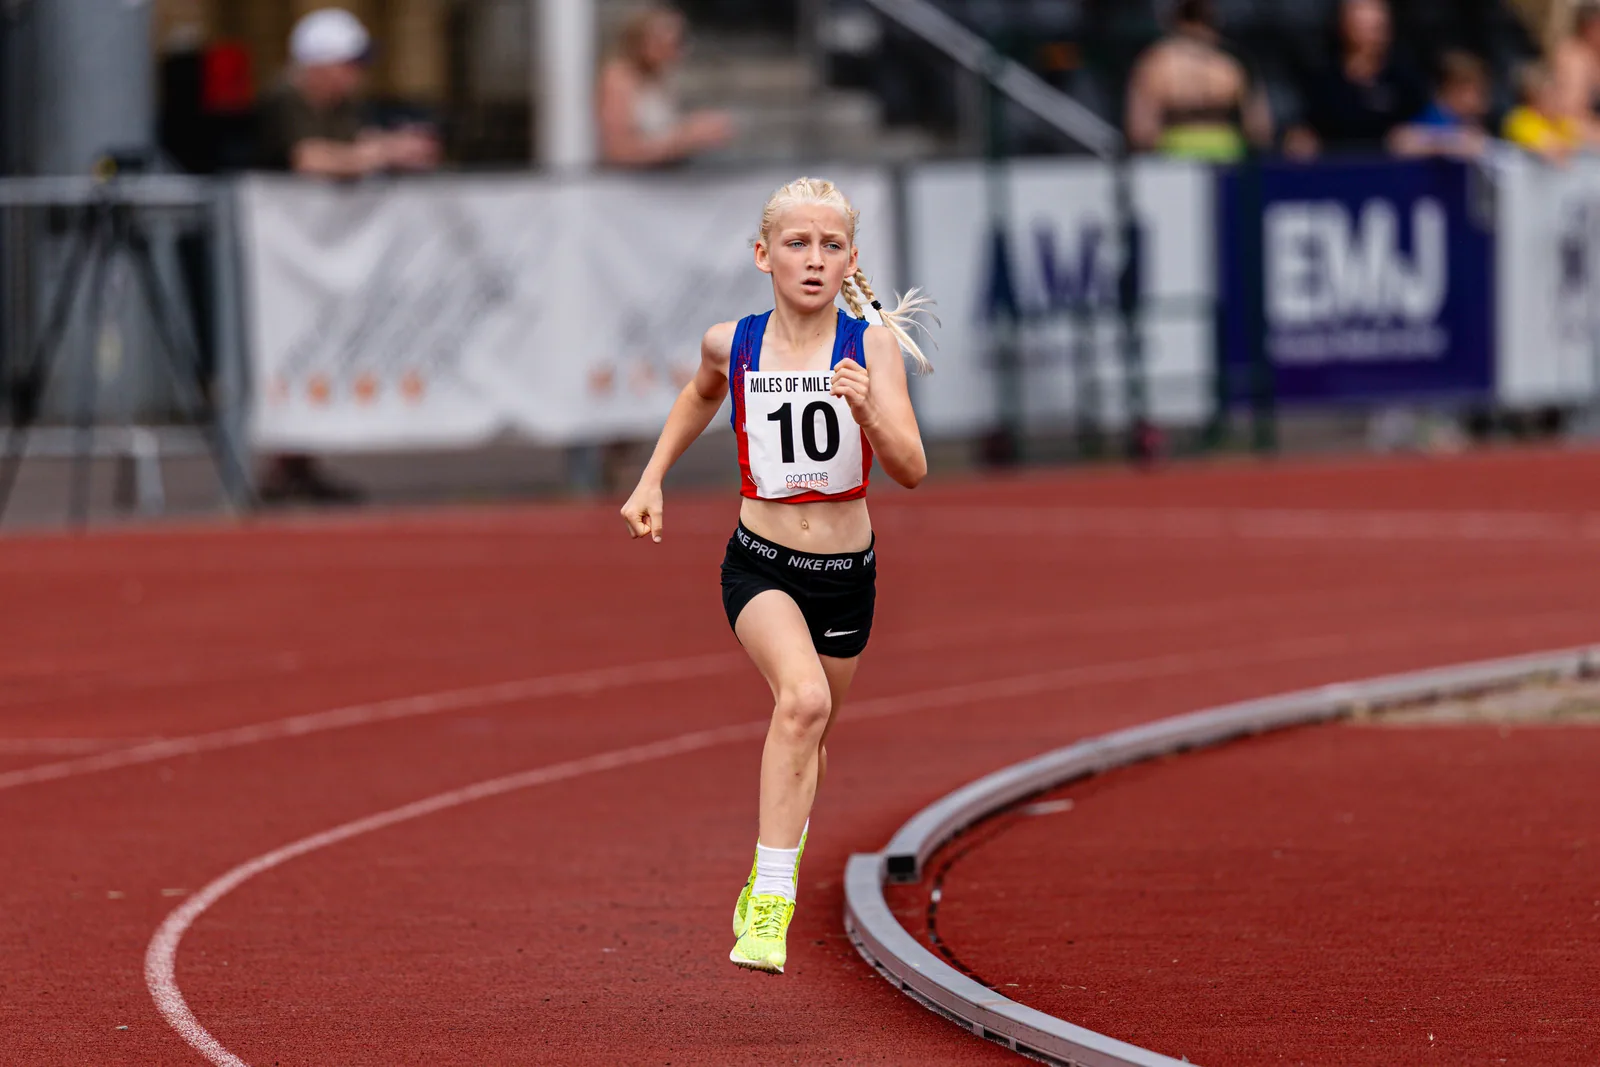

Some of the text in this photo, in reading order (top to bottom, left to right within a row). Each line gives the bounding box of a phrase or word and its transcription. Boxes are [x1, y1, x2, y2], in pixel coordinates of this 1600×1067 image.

[750, 376, 832, 393] MILES OF MILE
[767, 401, 840, 463] 10
[785, 472, 828, 483] comms
[786, 480, 829, 489] express
[749, 540, 778, 560] PRO
[787, 555, 853, 571] NIKE PRO
